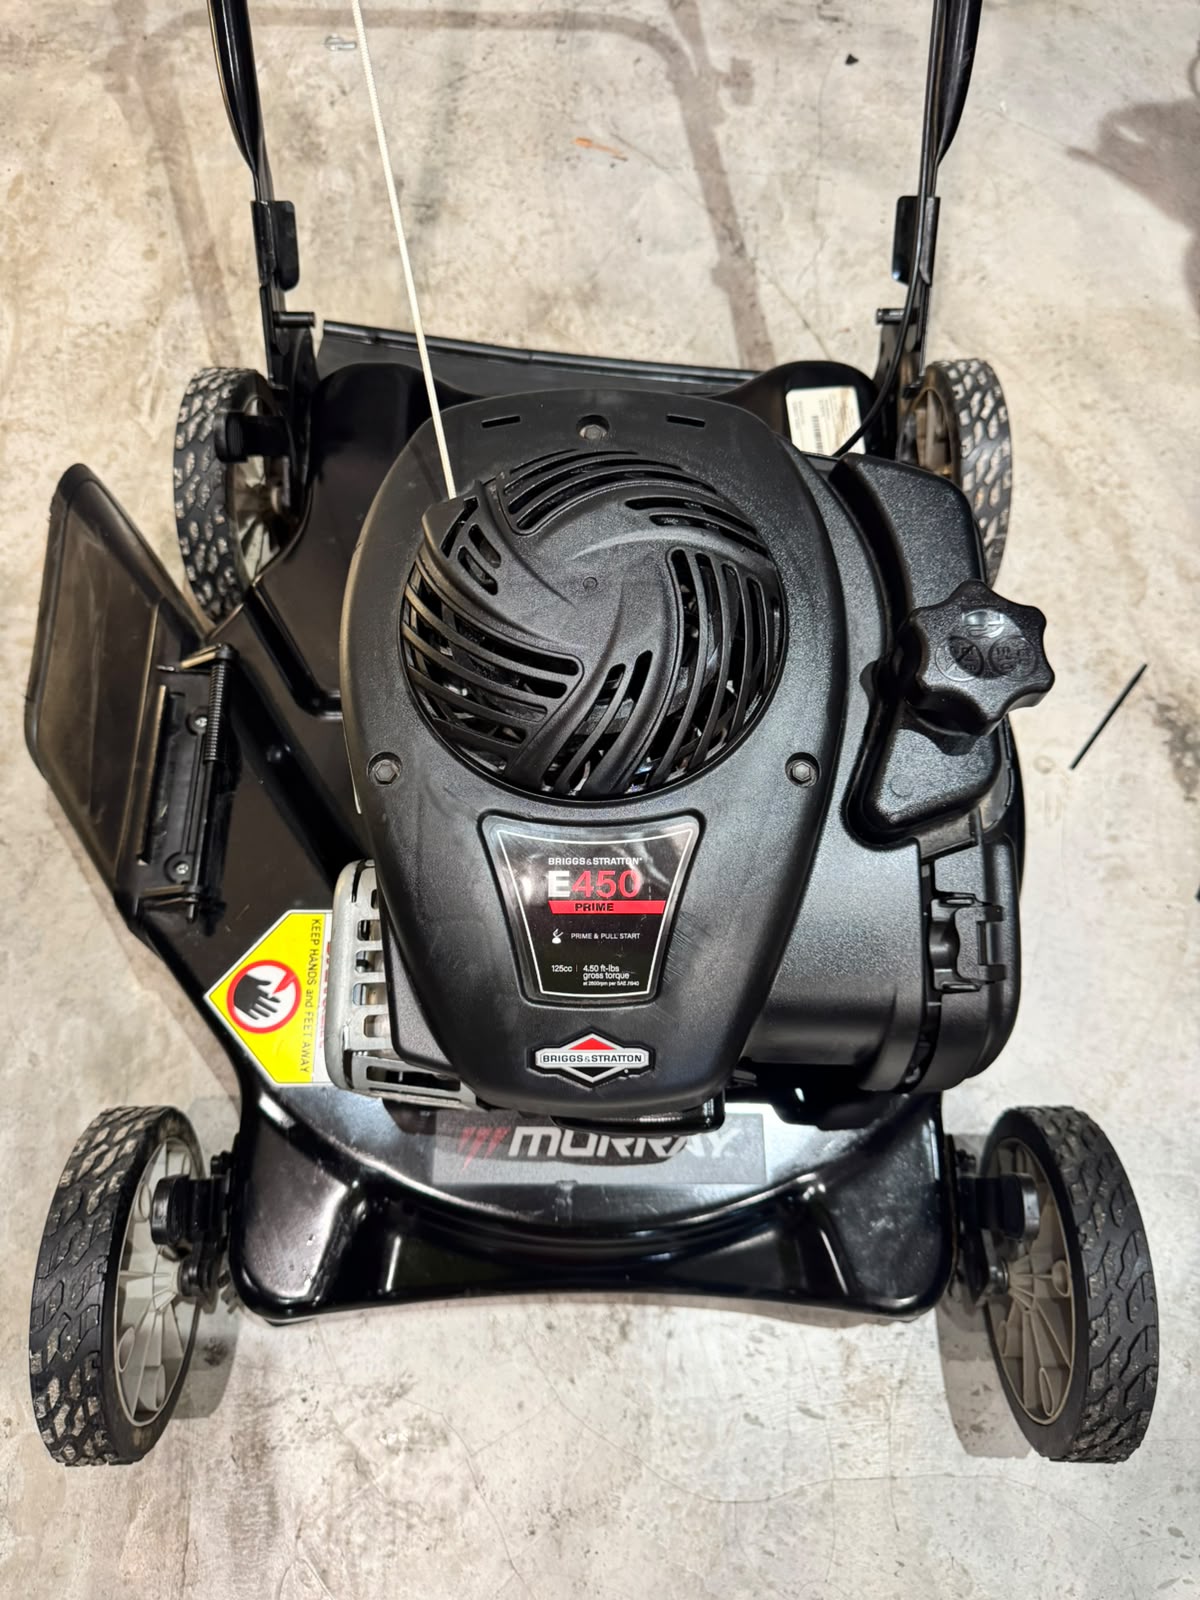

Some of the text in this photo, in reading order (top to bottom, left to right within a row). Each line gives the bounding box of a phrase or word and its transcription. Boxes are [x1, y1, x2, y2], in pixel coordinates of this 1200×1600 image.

[548, 870, 641, 898] E450
[575, 902, 614, 912] PRIME
[571, 932, 593, 940] PRIME
[600, 932, 618, 940] PULL
[619, 932, 641, 940] START
[551, 964, 573, 973] 125cc
[583, 964, 599, 973] 4.50
[583, 971, 630, 980] gross torque
[300, 918, 322, 1073] KEEP HANDS and FEET AWAY
